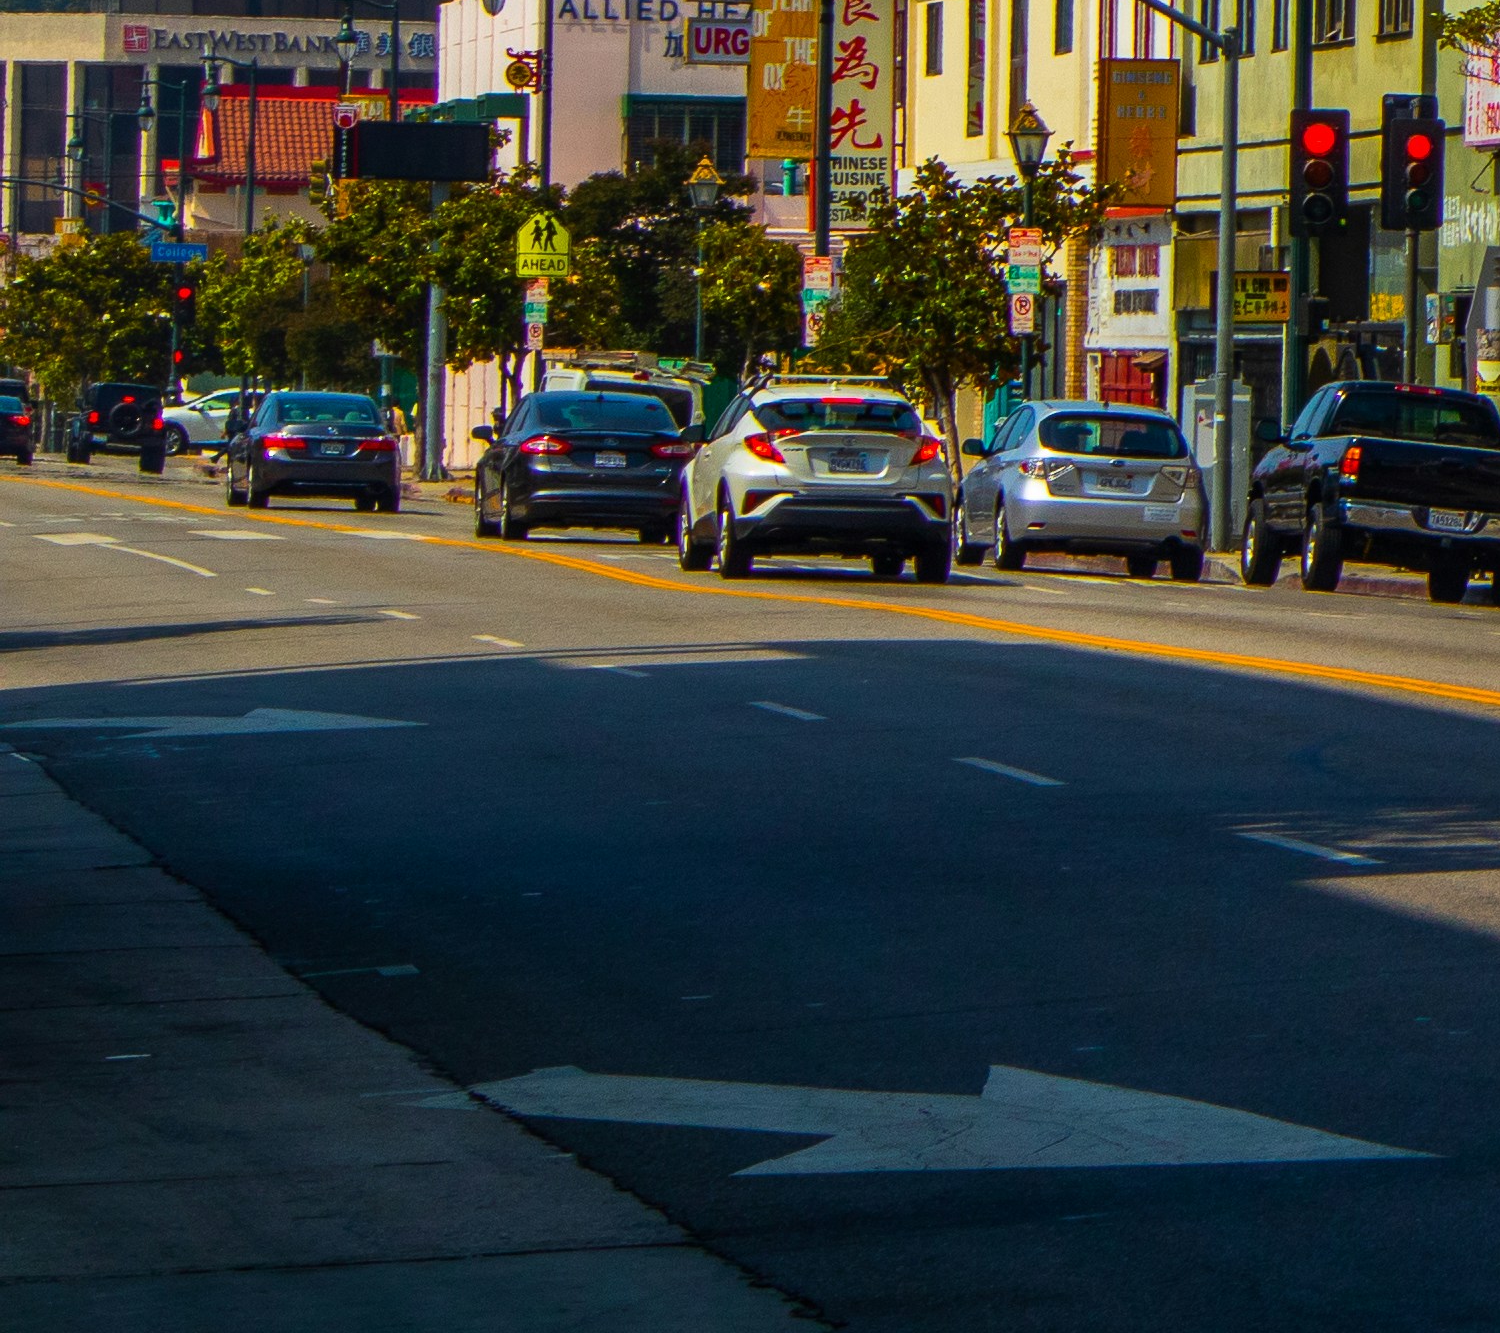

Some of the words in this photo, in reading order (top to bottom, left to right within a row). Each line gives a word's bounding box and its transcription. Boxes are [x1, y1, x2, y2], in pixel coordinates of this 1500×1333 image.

[753, 10, 772, 38] OF
[694, 27, 750, 56] URG
[783, 37, 816, 66] THE
[763, 62, 786, 90] OX
[830, 156, 888, 171] HINESE
[829, 171, 886, 186] UISINE
[521, 258, 566, 272] AHEAD
